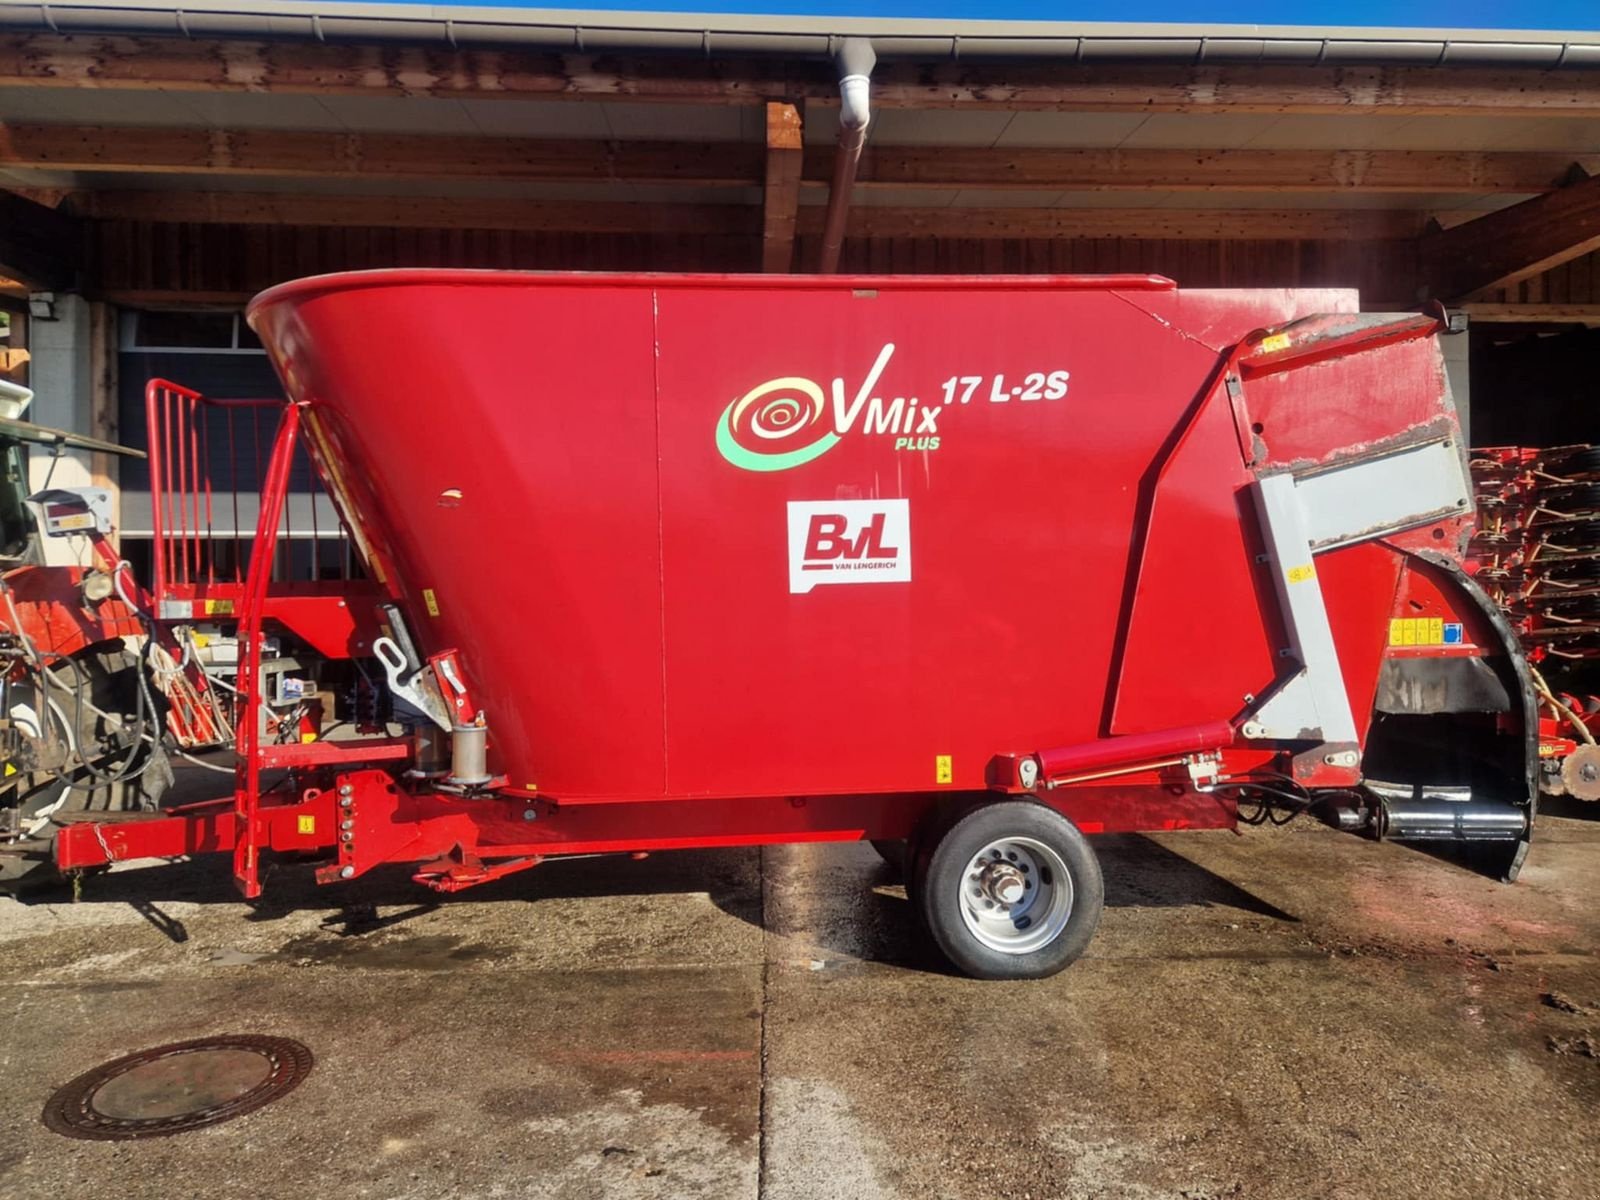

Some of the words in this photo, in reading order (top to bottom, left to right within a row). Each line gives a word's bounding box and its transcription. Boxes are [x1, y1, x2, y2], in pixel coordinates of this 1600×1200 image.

[942, 376, 982, 405] 17
[990, 370, 1070, 403] L-2S
[895, 436, 941, 450] PLUS
[835, 562, 852, 570] VAN
[853, 562, 897, 570] LENGERICH
